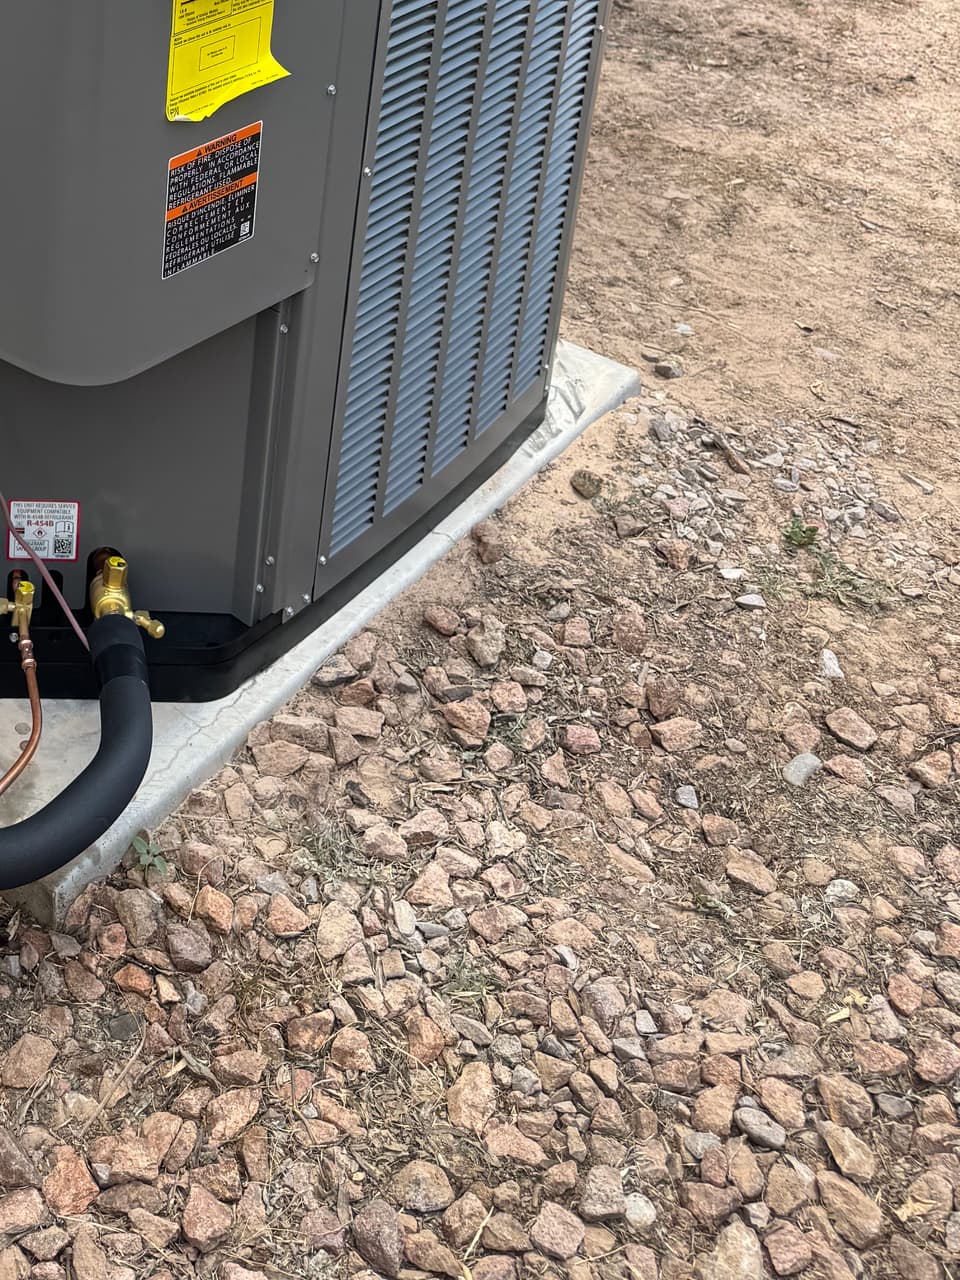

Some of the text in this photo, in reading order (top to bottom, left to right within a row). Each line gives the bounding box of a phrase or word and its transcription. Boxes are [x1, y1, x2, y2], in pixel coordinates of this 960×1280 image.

[170, 165, 185, 176] RISK
[187, 161, 195, 169] OF
[215, 142, 241, 157] DISPOSE
[243, 137, 250, 145] OF
[204, 135, 236, 153] WARNING
[169, 150, 256, 193] WITH FEDERAL OR LOCAL
[170, 142, 258, 184] PROPERLY IN ACCORDANCE
[219, 158, 257, 179] FLAMMABLE
[168, 177, 232, 210] REFRIGERANT USED.
[189, 181, 242, 209] AVERTISSEMENT
[167, 197, 243, 237] CORRECTEMENT ET
[167, 214, 189, 229] RISQUE
[235, 203, 249, 213] AUX
[200, 237, 208, 245] OU
